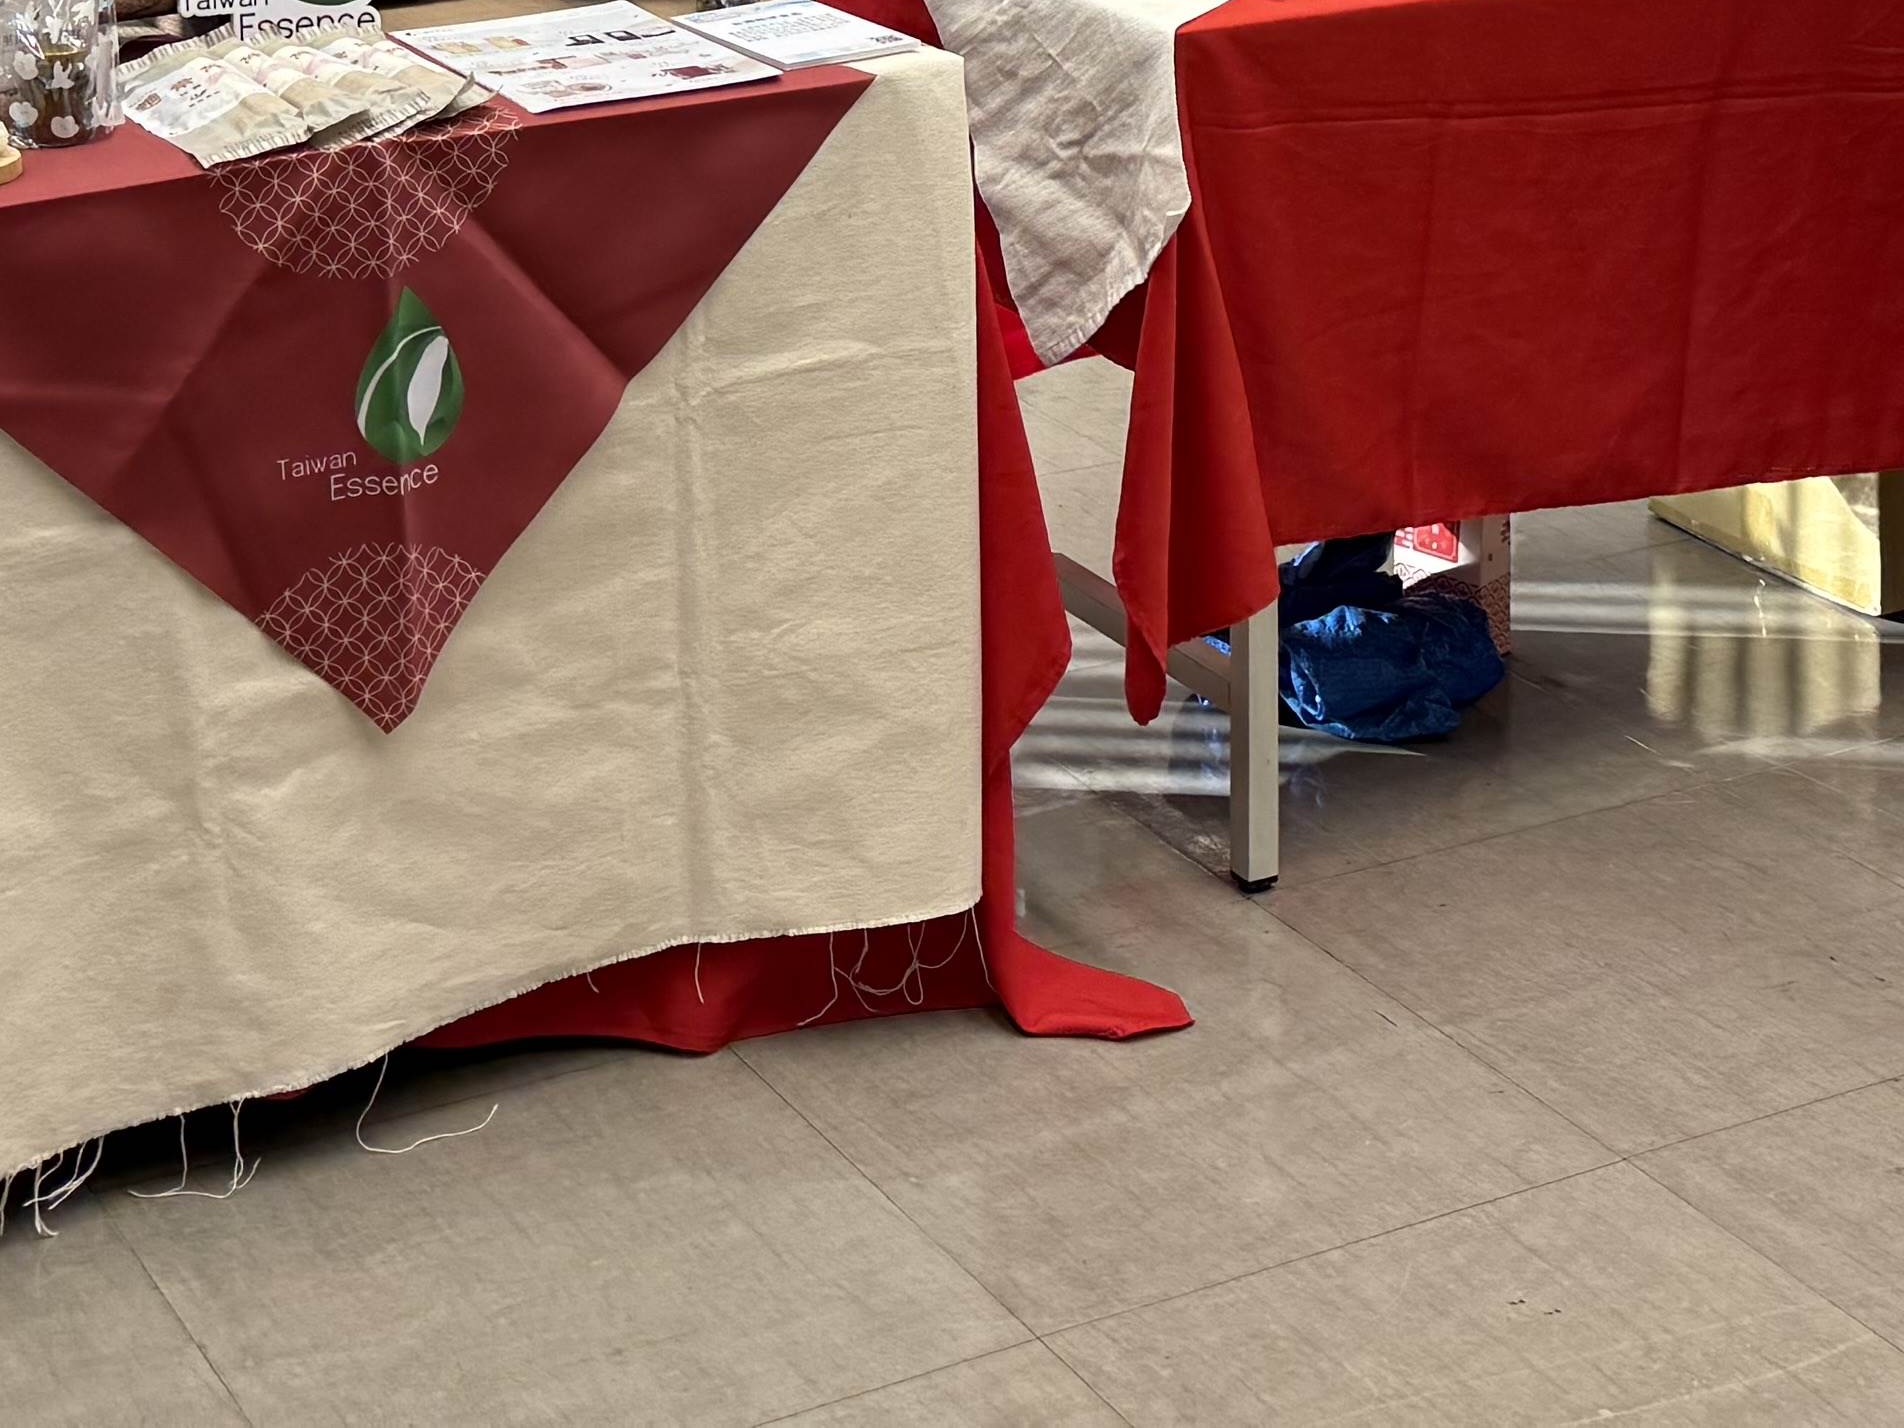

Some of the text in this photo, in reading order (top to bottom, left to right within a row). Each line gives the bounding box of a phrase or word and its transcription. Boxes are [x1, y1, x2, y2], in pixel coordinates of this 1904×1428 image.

[239, 10, 376, 42] Essence
[277, 451, 357, 480] Taiwan
[330, 463, 439, 502] Essence
